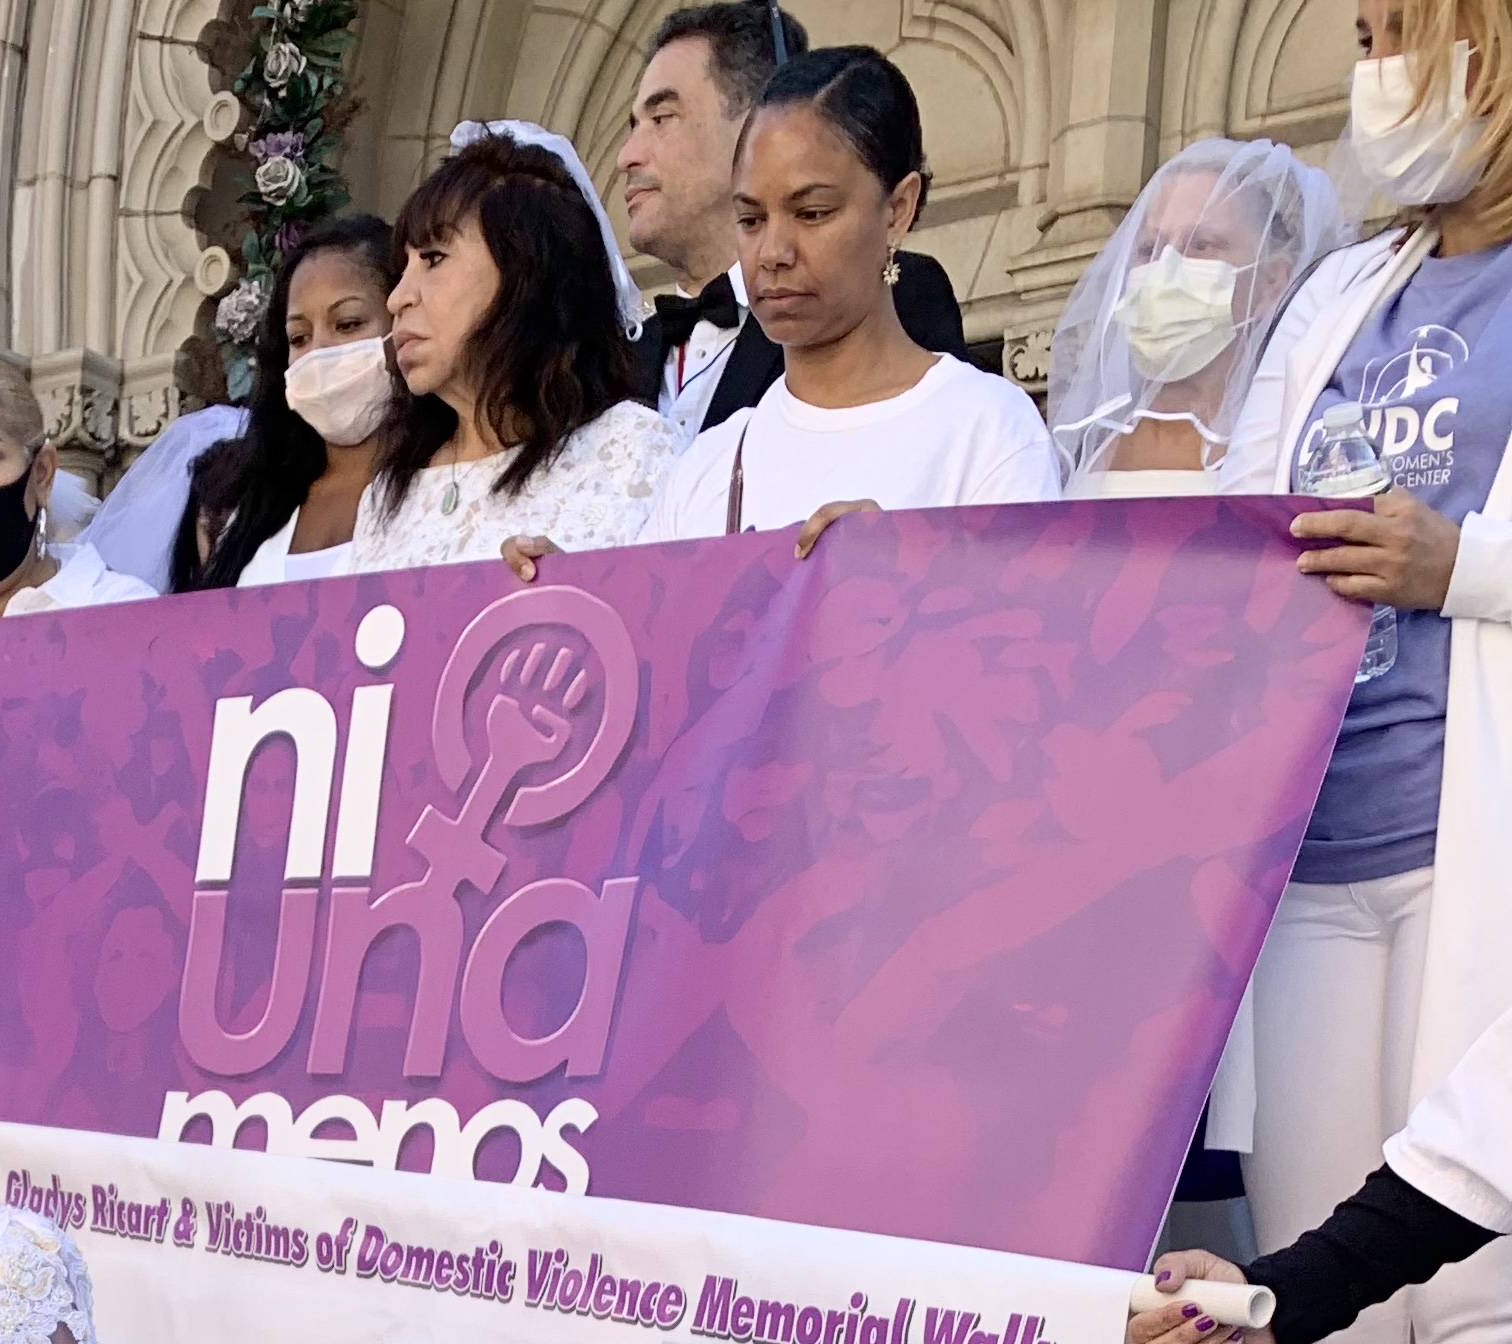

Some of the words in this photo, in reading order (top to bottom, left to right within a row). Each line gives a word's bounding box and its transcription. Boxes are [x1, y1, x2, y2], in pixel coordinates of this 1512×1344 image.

[1389, 451, 1454, 472] OMEN'S
[1393, 469, 1452, 487] CENTER
[195, 603, 405, 881] ni
[178, 875, 641, 1083] una
[5, 1169, 85, 1231] Gladys
[90, 1183, 173, 1243] Ricart
[173, 1196, 199, 1248] &
[206, 1200, 309, 1268] Victims
[315, 1216, 358, 1275] of
[356, 1223, 517, 1301] Domestic
[523, 1247, 687, 1332] Violence
